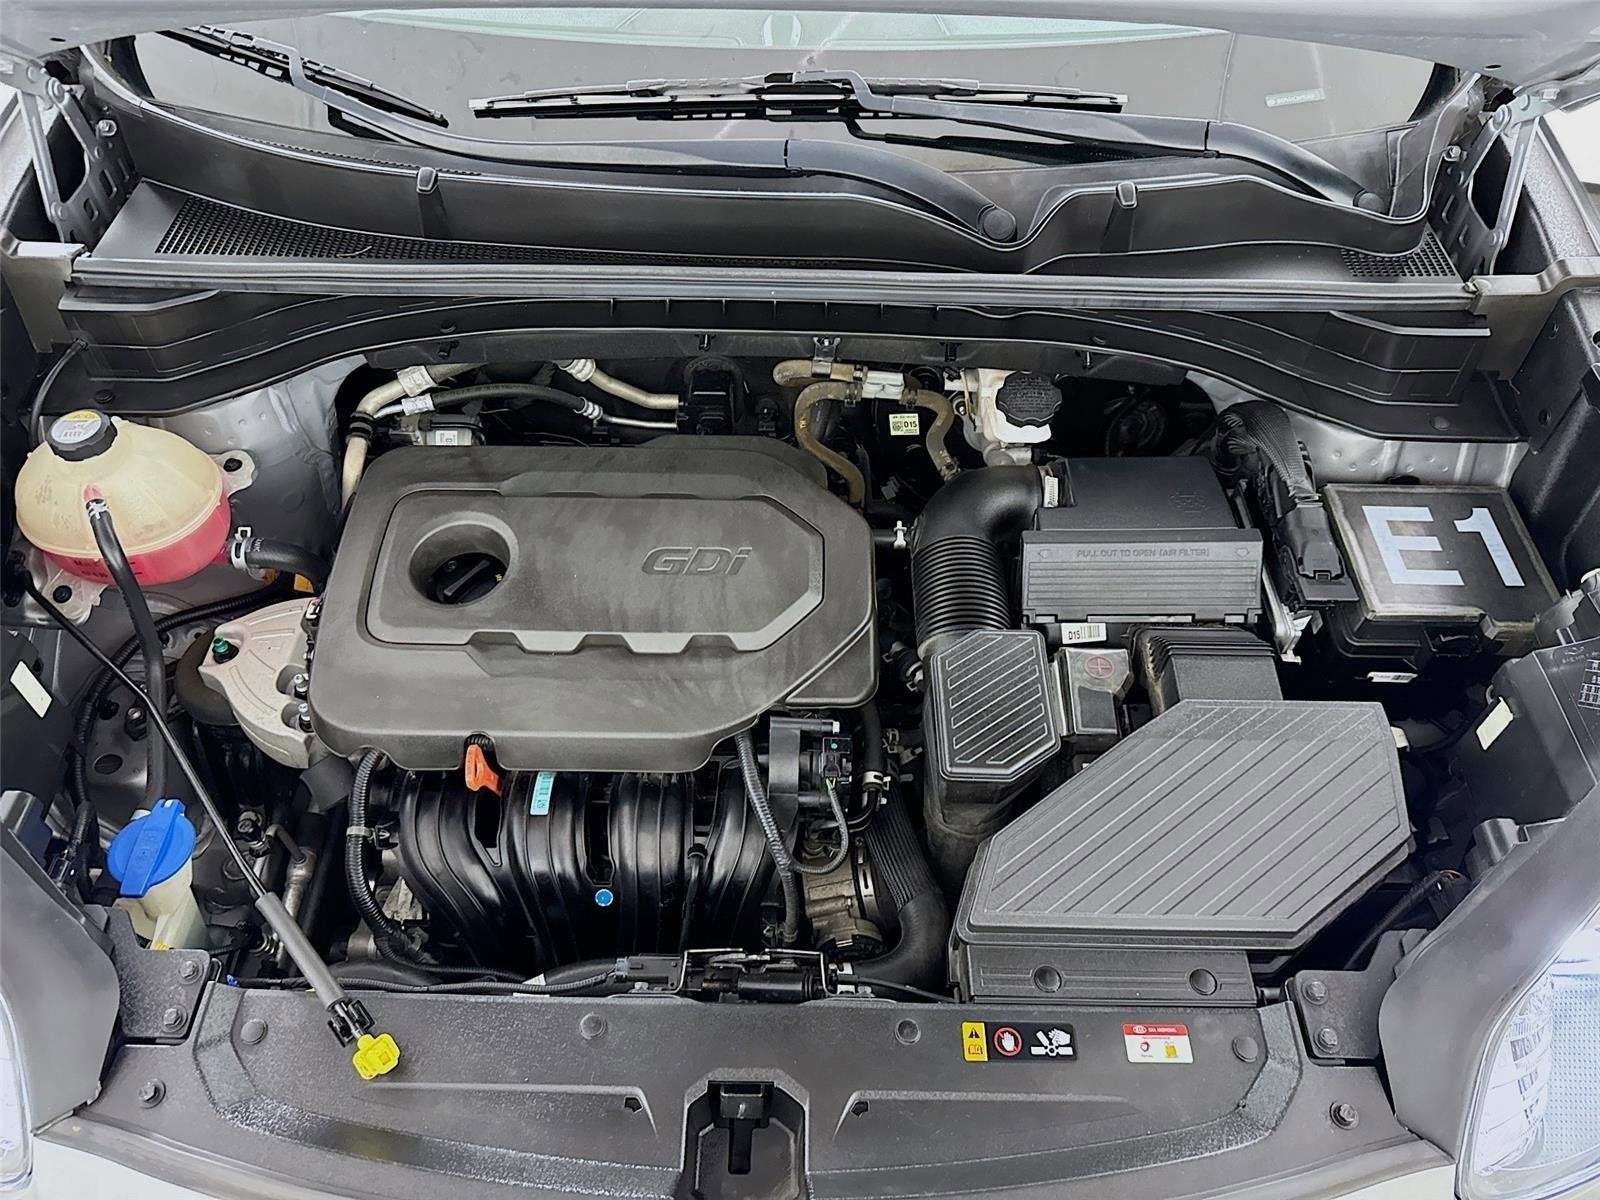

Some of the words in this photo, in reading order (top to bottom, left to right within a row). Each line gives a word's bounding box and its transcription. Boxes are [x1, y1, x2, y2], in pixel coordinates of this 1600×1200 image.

[641, 546, 753, 575] GDi
[1076, 549, 1098, 558] PULL
[1100, 548, 1118, 557] OUT
[1119, 548, 1131, 557] TO
[1132, 548, 1156, 557] OPEN
[1361, 505, 1525, 587] E1
